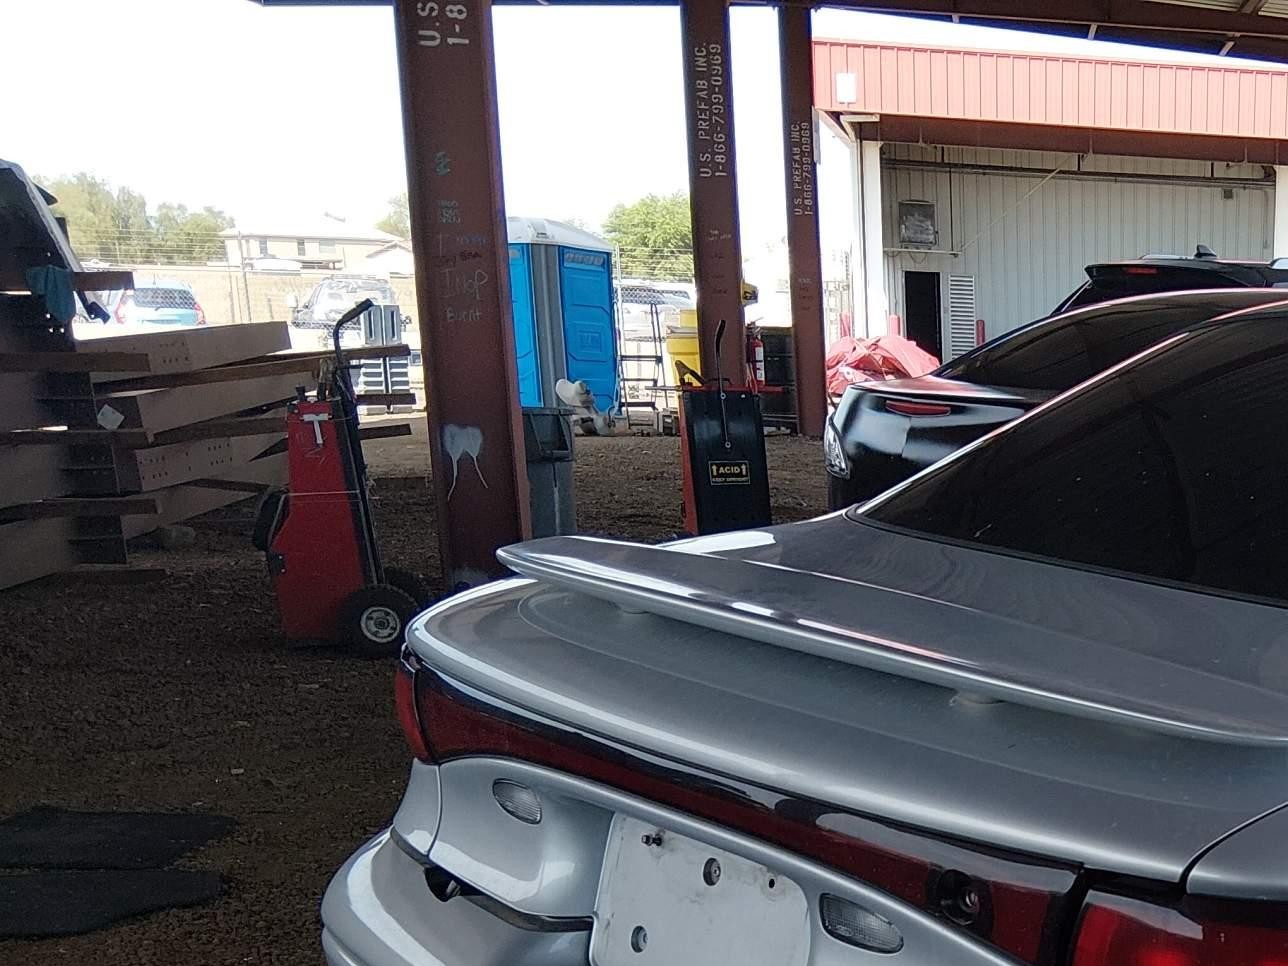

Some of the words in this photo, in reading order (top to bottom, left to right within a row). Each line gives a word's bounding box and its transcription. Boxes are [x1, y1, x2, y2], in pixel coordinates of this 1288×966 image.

[694, 42, 708, 72] INC.
[695, 79, 711, 140] PREFAB
[709, 43, 728, 177] 1-866-799-0969
[790, 120, 801, 143] INC.
[699, 147, 713, 178] U.S.
[791, 146, 803, 190] PREFAB
[719, 466, 740, 474] ACID
